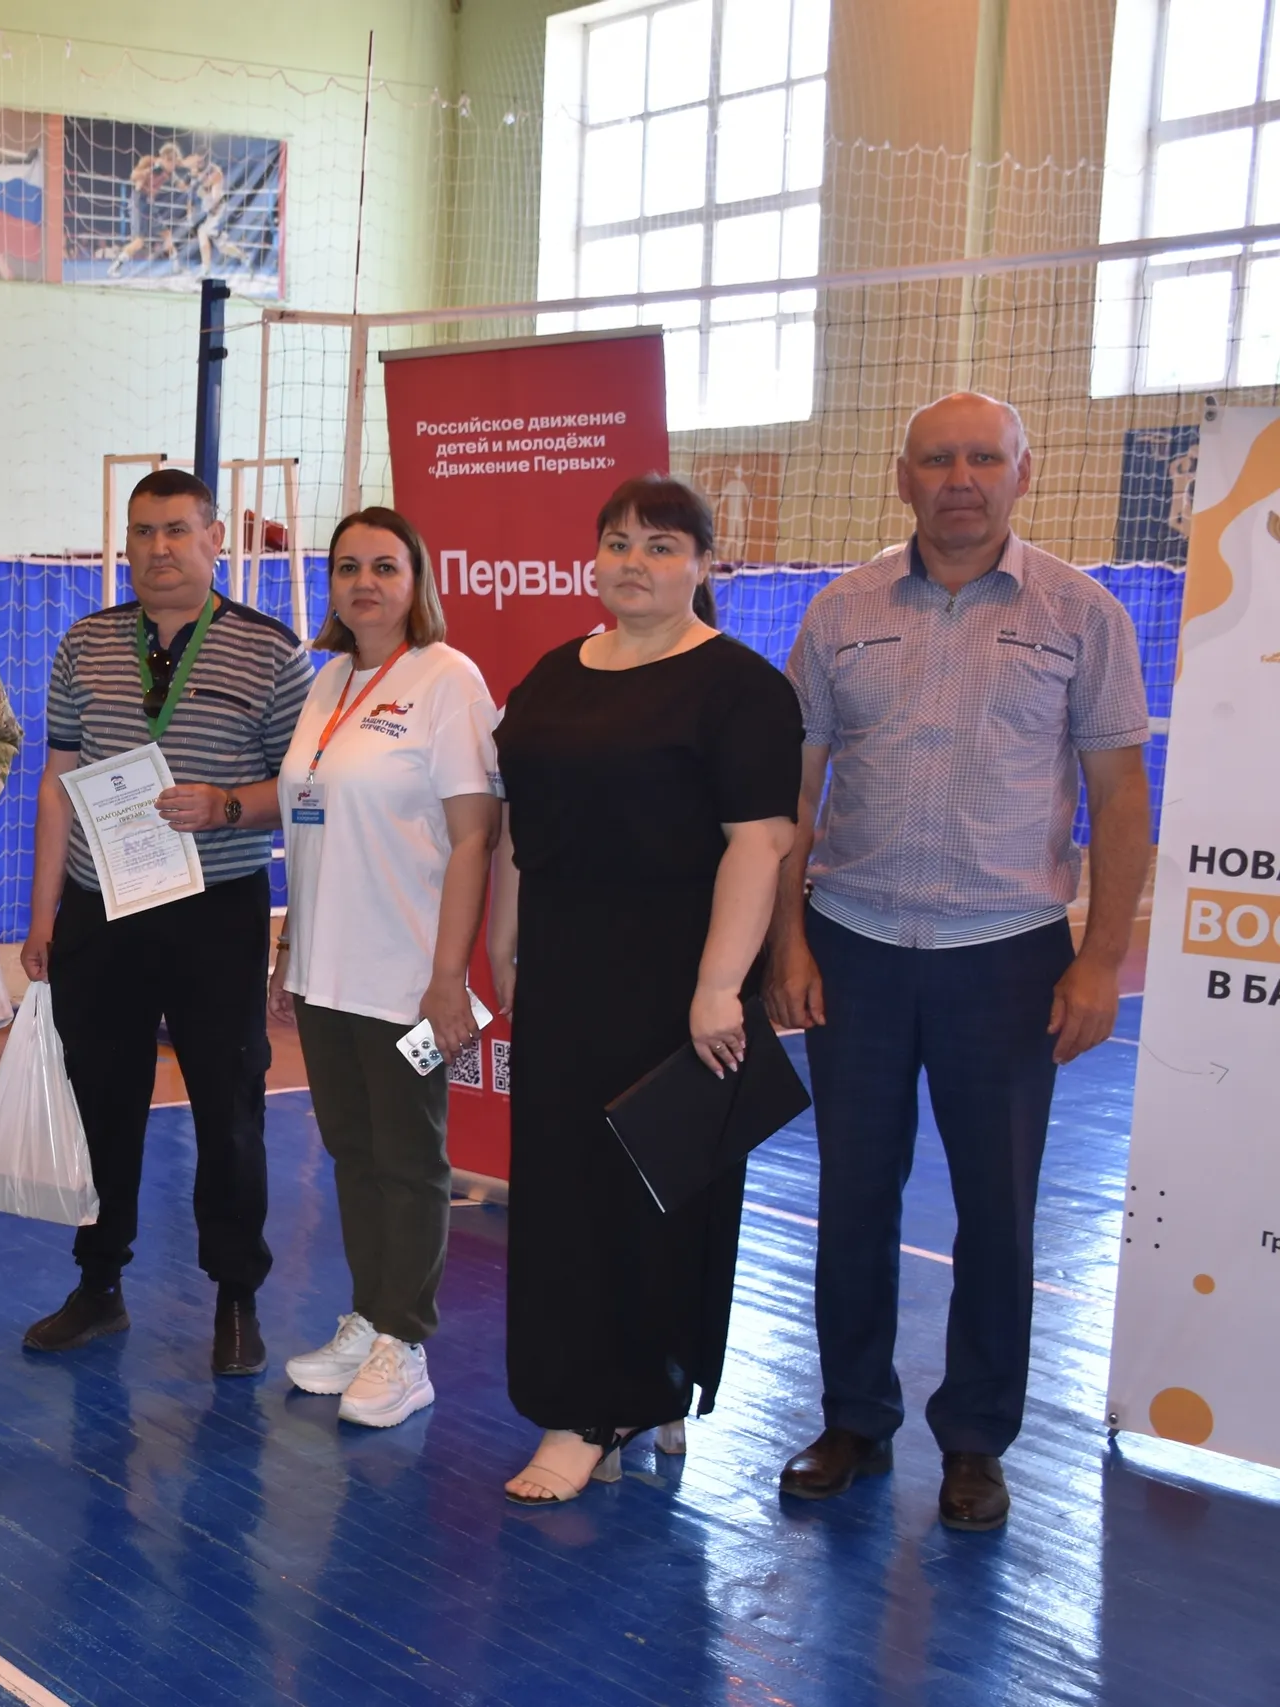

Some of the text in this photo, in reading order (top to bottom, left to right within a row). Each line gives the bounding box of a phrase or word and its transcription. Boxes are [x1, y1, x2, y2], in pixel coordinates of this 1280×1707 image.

[416, 411, 626, 436] Российское движение
[436, 433, 606, 457] детей и молодёжи
[428, 455, 616, 479] «Движение Первых»
[440, 550, 599, 610] Первые
[360, 723, 400, 739] ОТЕЧЕСТВА
[361, 717, 408, 734] ЗАЩИТНИКИ
[95, 798, 158, 823] БЛАГОДАРСТВЕННО
[1188, 844, 1280, 882] НОВ
[1188, 900, 1280, 948] ВО
[1207, 970, 1231, 999] В
